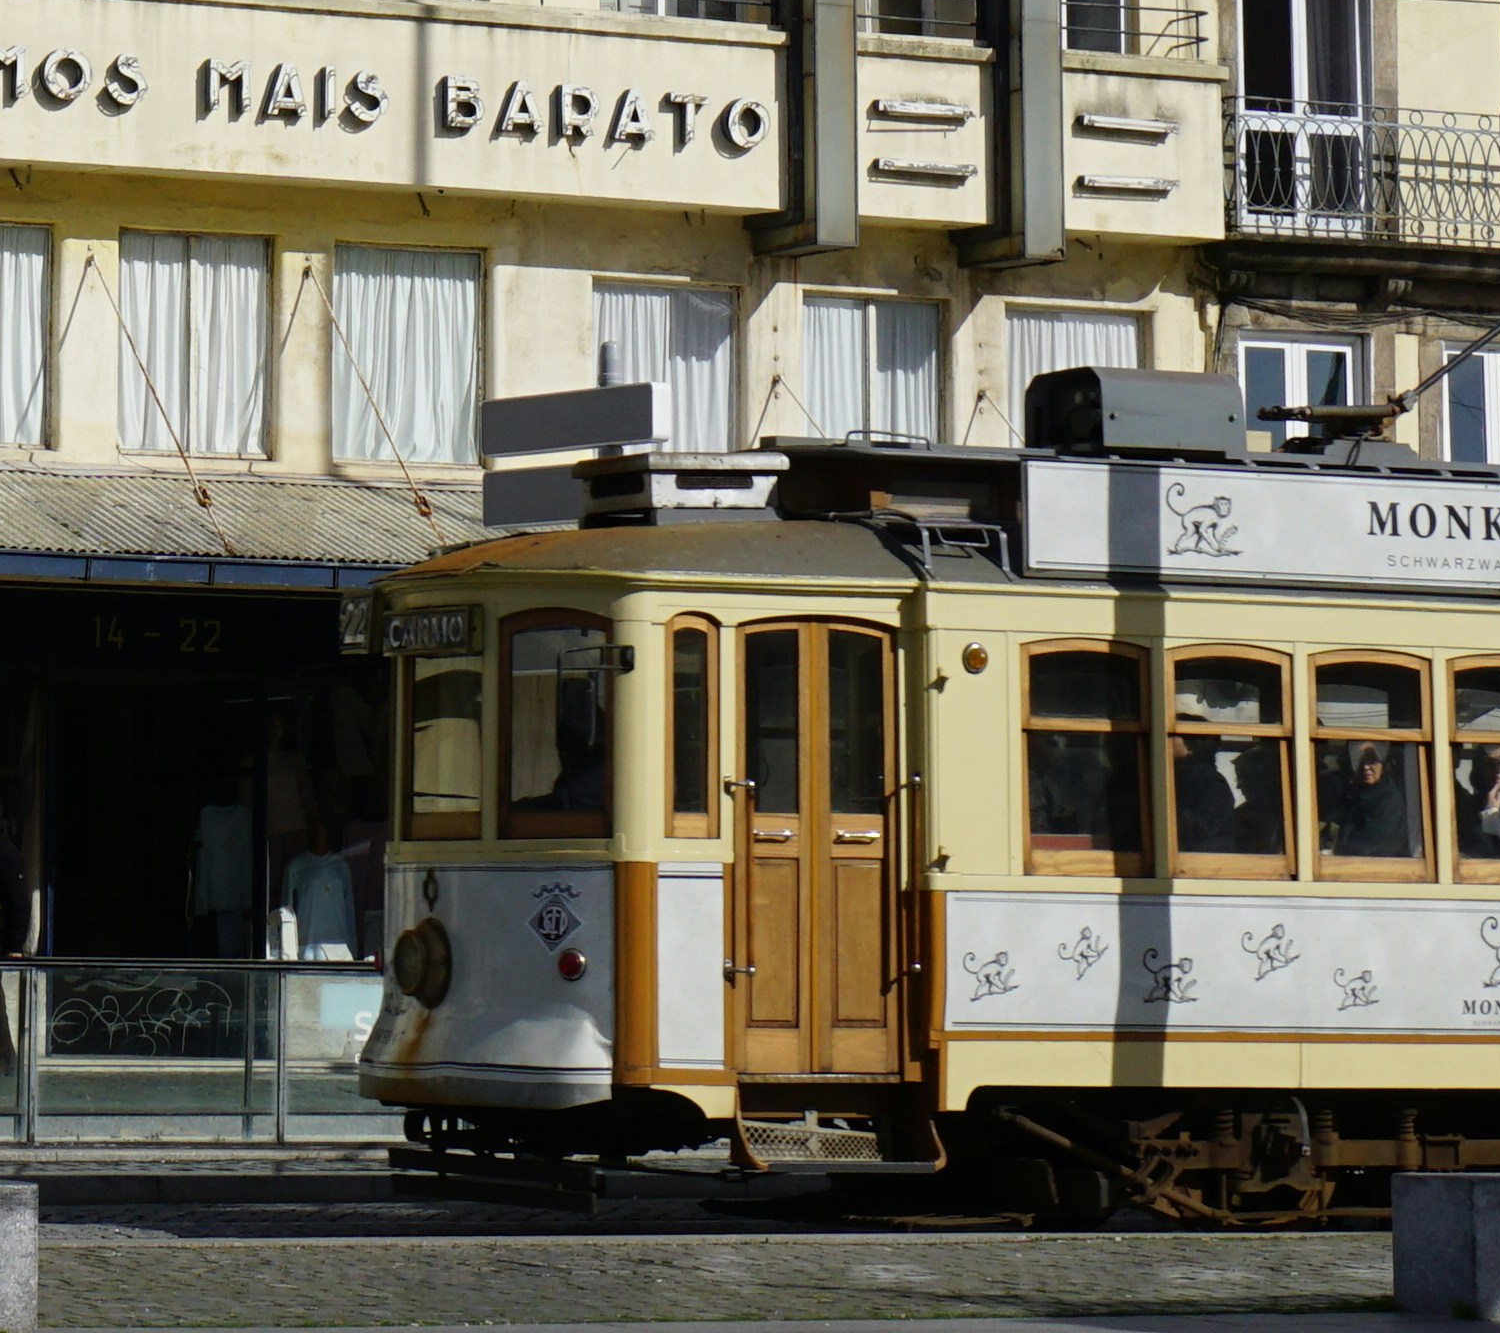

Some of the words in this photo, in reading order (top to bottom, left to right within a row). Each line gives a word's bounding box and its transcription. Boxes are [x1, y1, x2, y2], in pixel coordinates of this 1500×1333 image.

[205, 56, 390, 126] MAIS
[441, 75, 774, 153] BARATO
[94, 615, 125, 650] 14
[179, 618, 221, 652] 22
[340, 602, 367, 644] 22
[389, 614, 463, 648] CARMO
